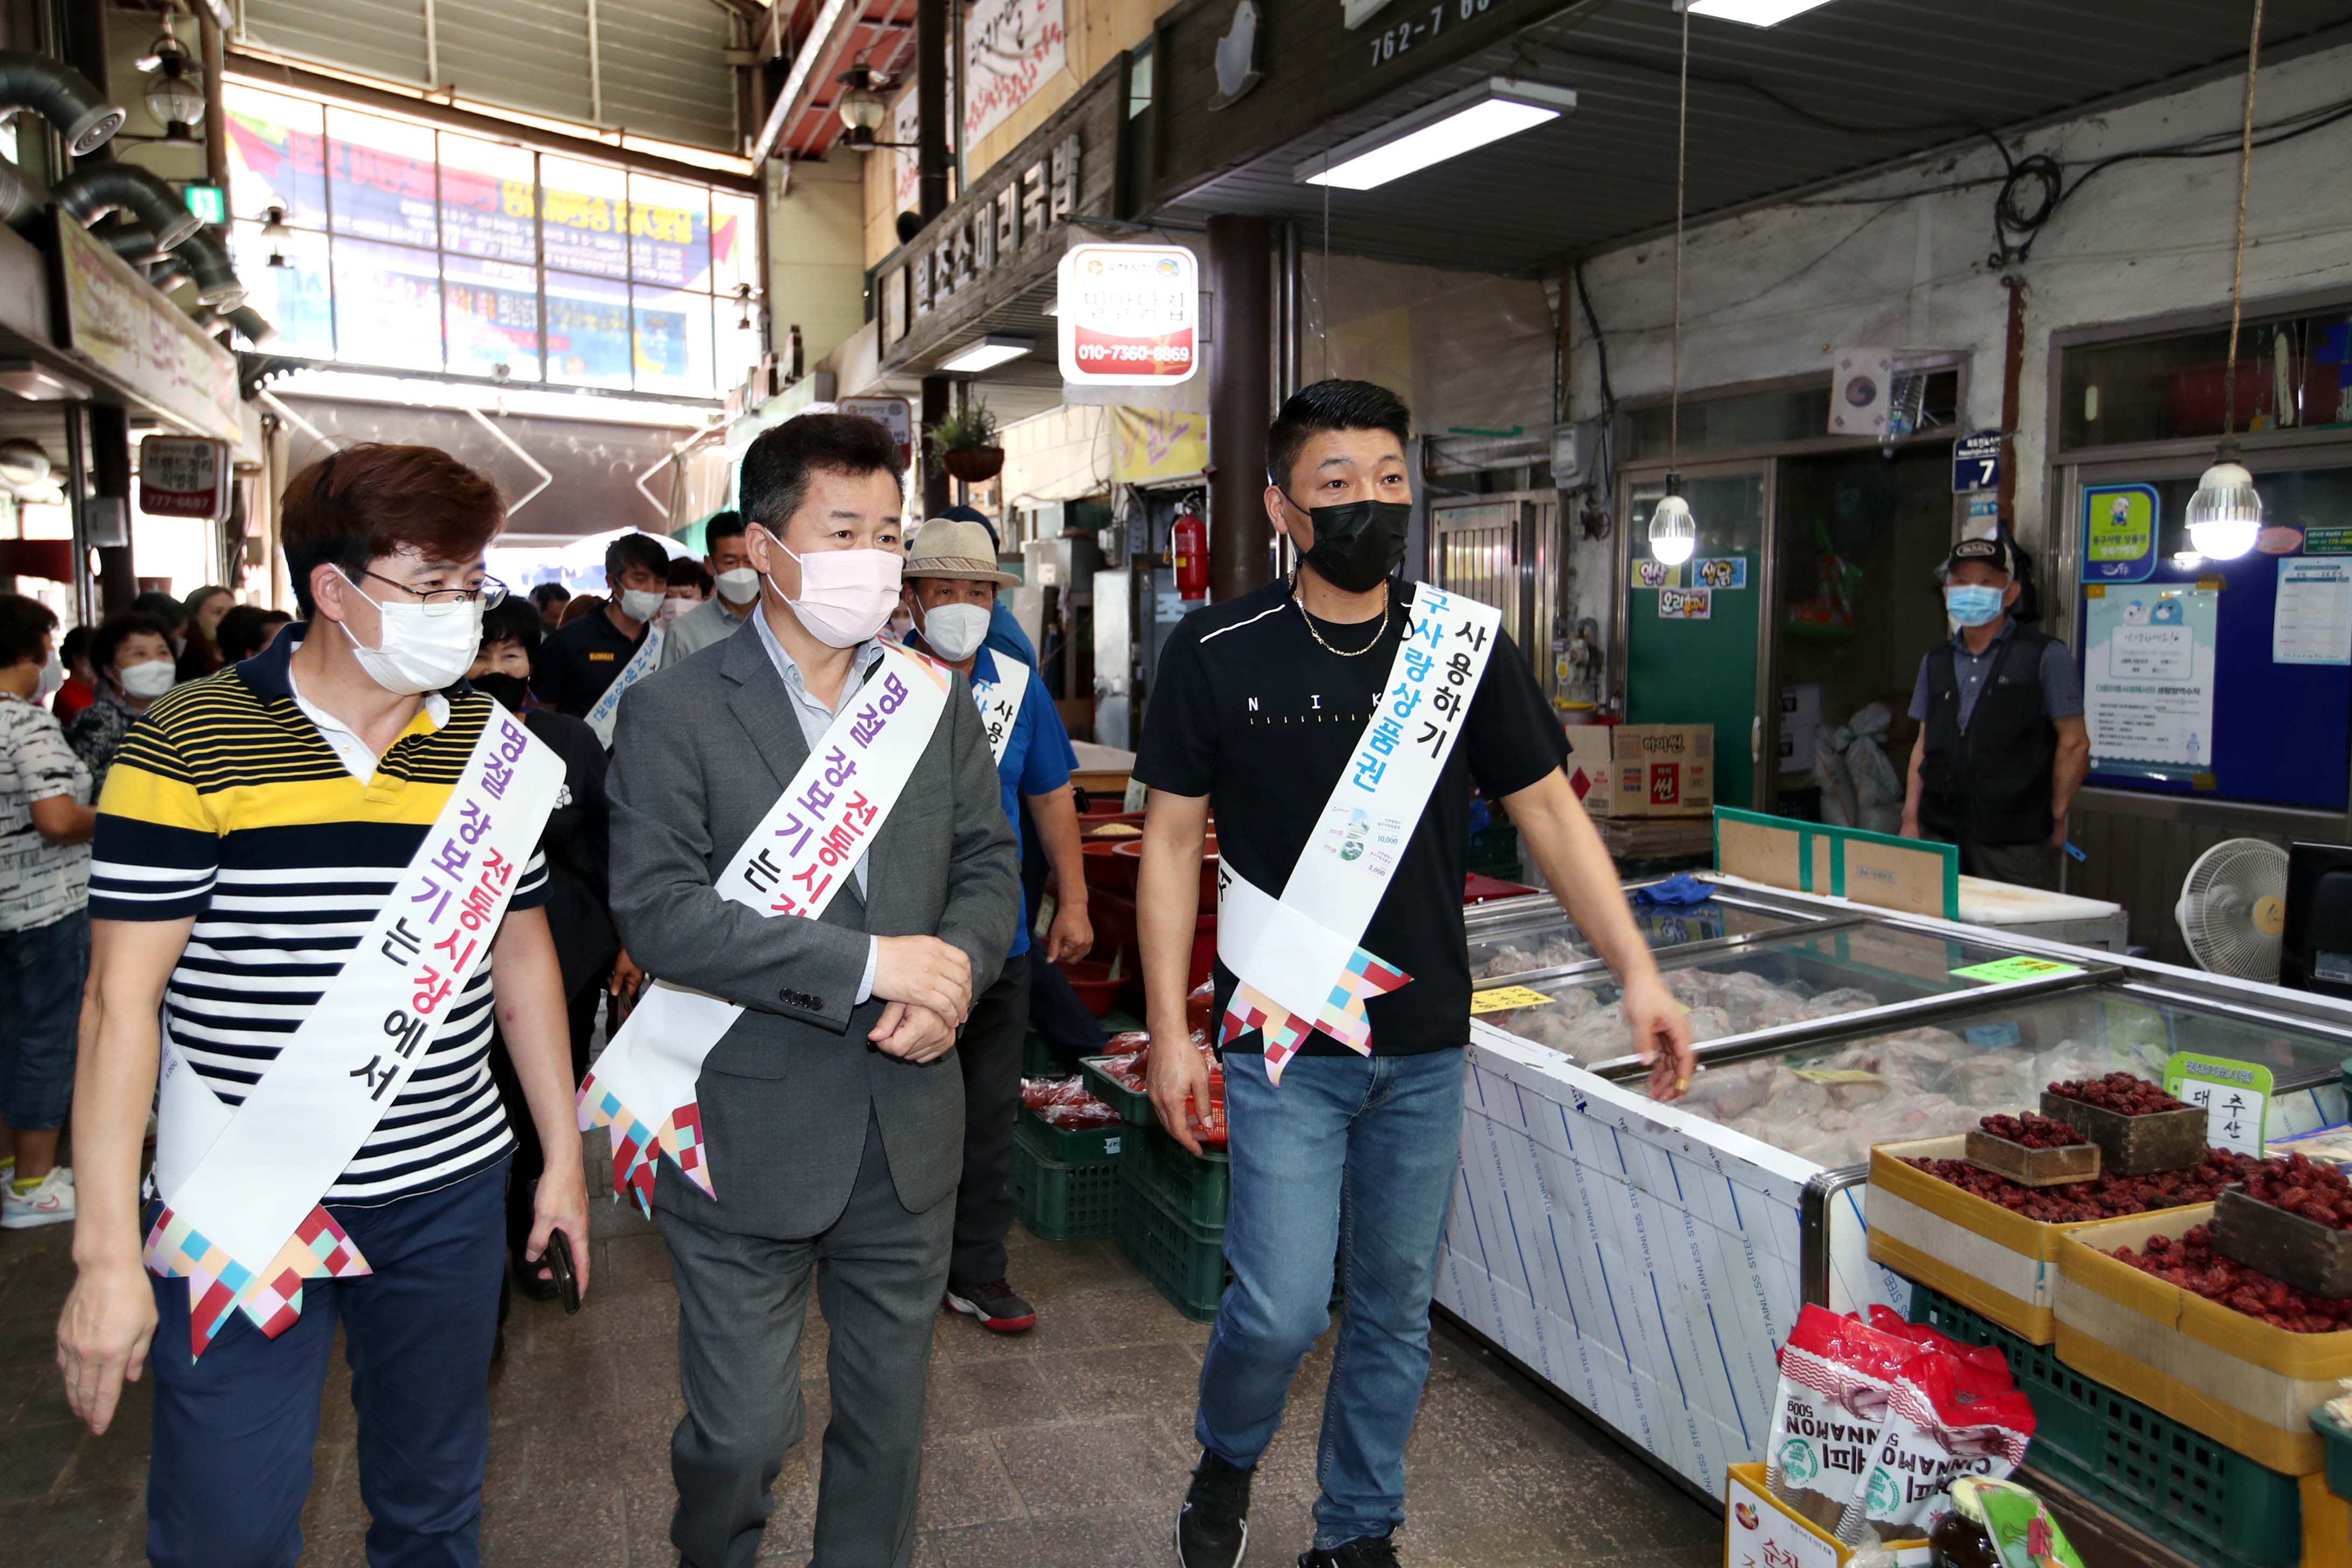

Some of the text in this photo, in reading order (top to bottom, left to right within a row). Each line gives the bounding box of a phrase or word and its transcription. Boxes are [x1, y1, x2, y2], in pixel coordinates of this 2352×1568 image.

[1078, 344, 1190, 362] 010-7360-8869
[1979, 459, 1995, 485] 7
[1352, 586, 1451, 793] 구사랑상품권
[1417, 621, 1488, 760] 사용하기
[987, 699, 1014, 755] 사용
[744, 671, 909, 894] 명절 장보기는
[381, 718, 528, 967] 명절 장보기는
[1377, 835, 1398, 845] 10,000
[1368, 864, 1386, 877] 5,000
[349, 846, 514, 1102] 전통시장에서
[2185, 1060, 2254, 1084] 원산지표시판
[2223, 1121, 2241, 1139] 산
[1534, 1162, 1552, 1212] STAINLESS
[1580, 1187, 1599, 1240] STAINLESS
[1627, 1179, 1653, 1268] STAINLESS STEEL
[1682, 1206, 1711, 1301] STAINLESS STEEL
[1742, 1235, 1776, 1335] STAINLESS STEEL
[1884, 1271, 1902, 1304] STEEL
[1533, 1314, 1544, 1341] STEEL
[1579, 1346, 1590, 1373] STEEL
[1630, 1378, 1644, 1409] STEEL
[1787, 1400, 1814, 1418] 500g
[1686, 1417, 1701, 1448] STEEL
